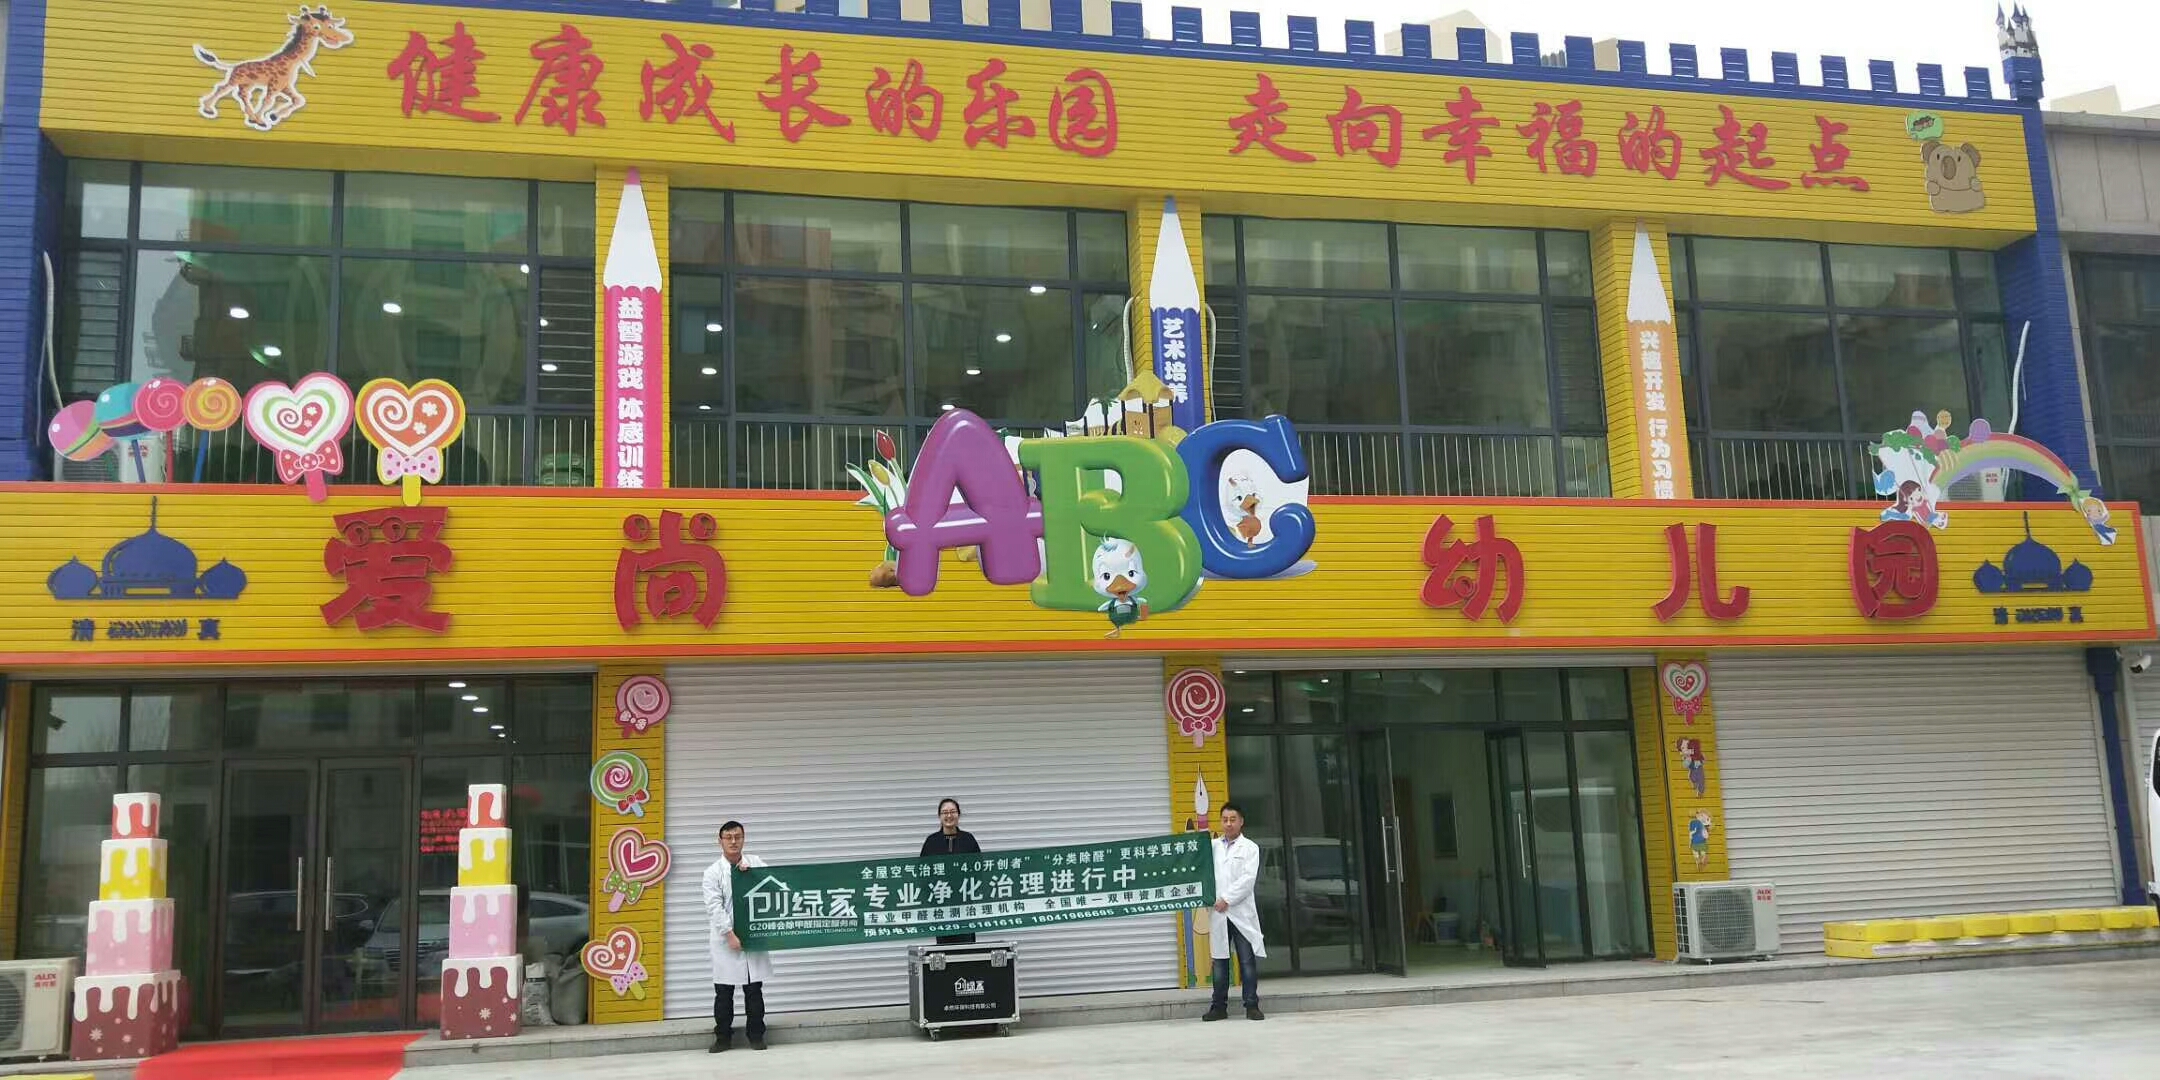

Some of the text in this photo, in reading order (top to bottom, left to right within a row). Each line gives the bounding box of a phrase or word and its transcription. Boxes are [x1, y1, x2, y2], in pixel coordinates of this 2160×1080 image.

[388, 22, 1868, 190] 健康成长的乐园 走向幸福的起点
[617, 296, 644, 488] 益智游戏 体感训练
[1649, 418, 1674, 499] 行为习惯
[322, 406, 1939, 633] 爱尚 ABC 幼儿园
[744, 875, 858, 921] 创绿家
[861, 863, 946, 880] 全屋空气治理
[1120, 840, 1199, 861] 更科学更有效
[868, 885, 1197, 923] 专业甲醛检测治理机构 全国唯一双甲资质企业
